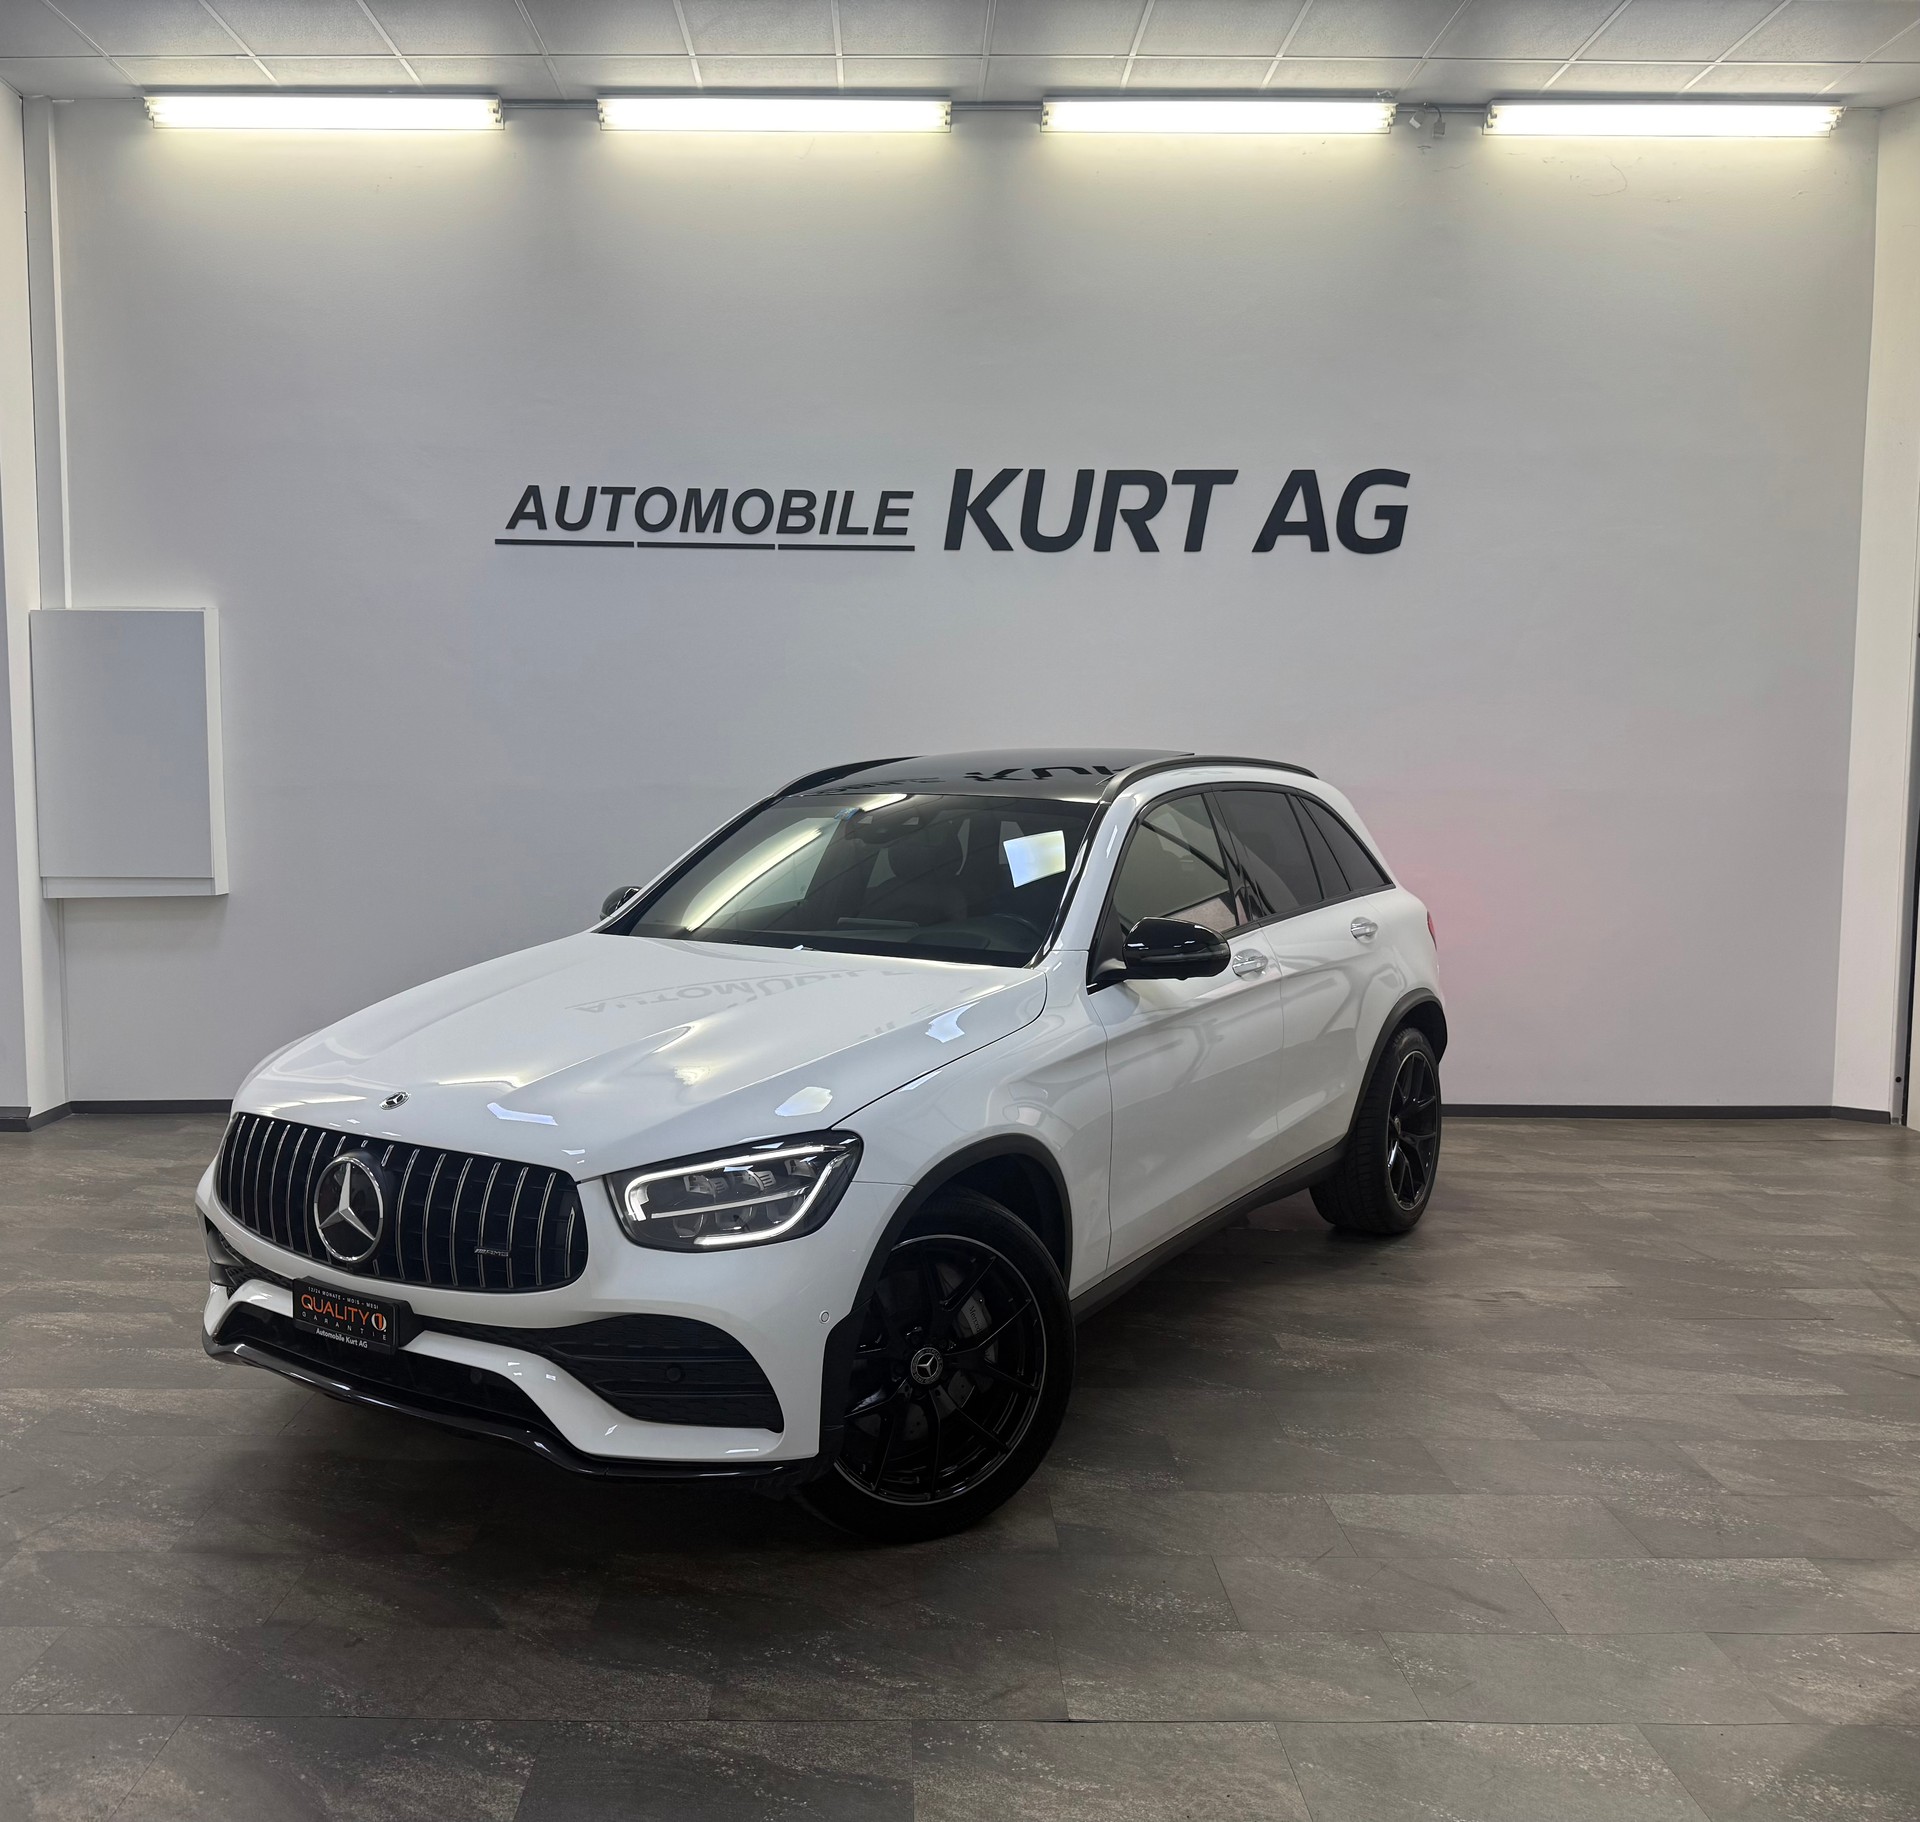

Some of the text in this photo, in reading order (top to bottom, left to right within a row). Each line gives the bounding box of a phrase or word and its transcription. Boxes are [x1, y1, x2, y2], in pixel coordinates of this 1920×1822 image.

[505, 468, 1411, 555] AUTOMOBILE KURT AG
[301, 1293, 370, 1326] QUALITY
[968, 1305, 982, 1332] Merced
[316, 1328, 368, 1349] Automobile Kurt AG
